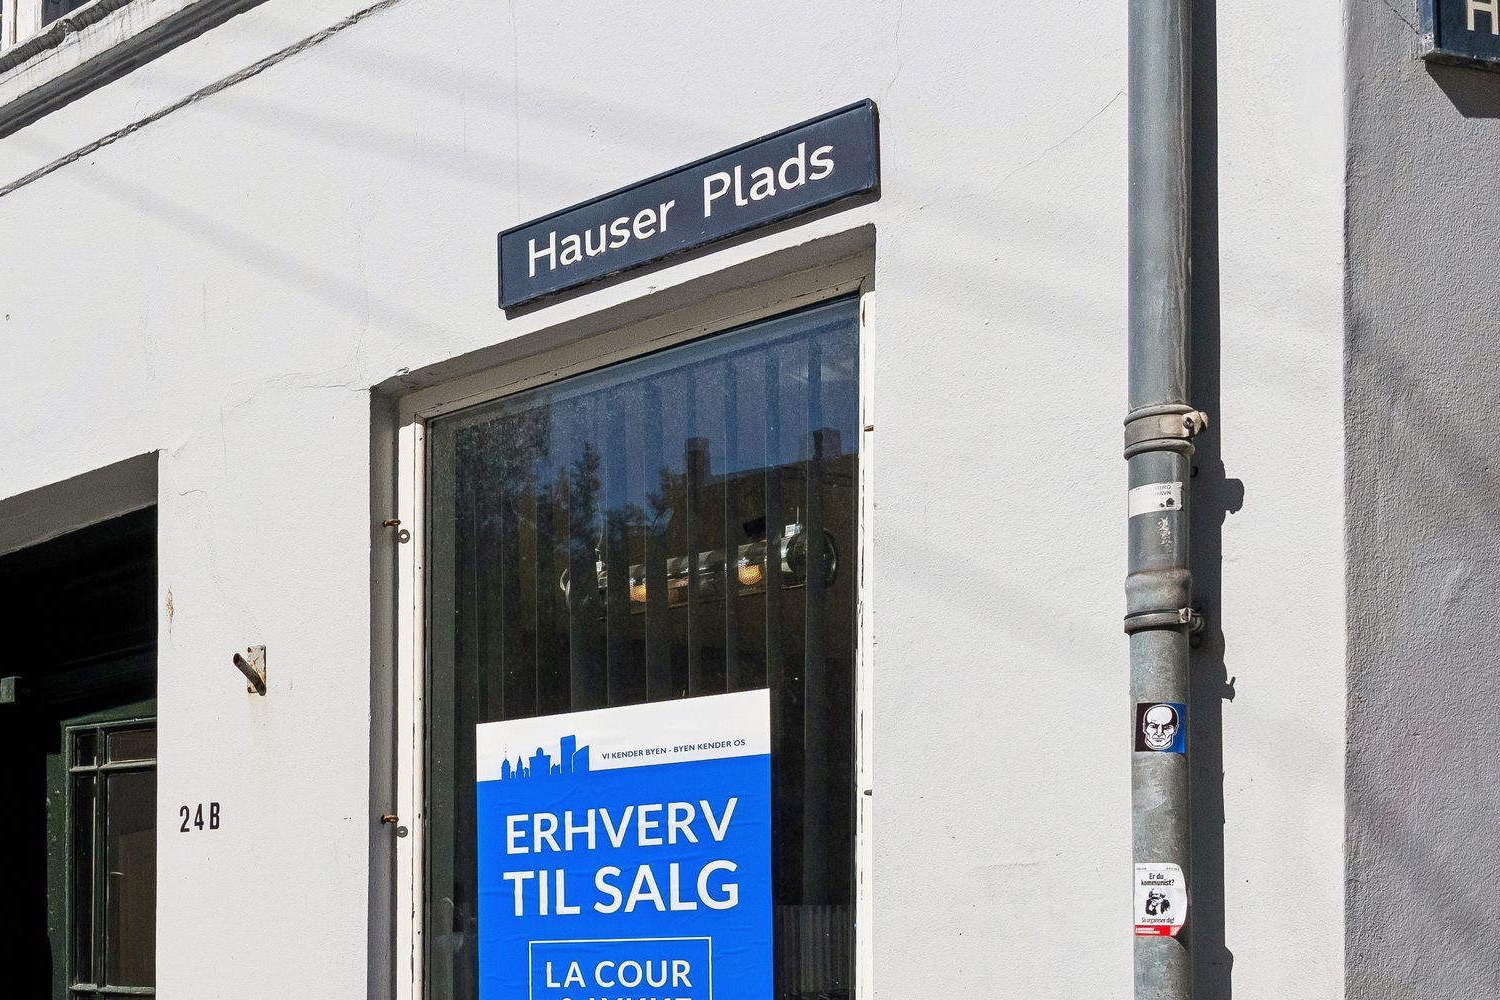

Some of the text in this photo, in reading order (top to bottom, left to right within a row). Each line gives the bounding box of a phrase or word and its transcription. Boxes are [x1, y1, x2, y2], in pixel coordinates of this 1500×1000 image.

[527, 141, 836, 278] Hauser Plads
[611, 749, 644, 759] KENDER
[645, 747, 667, 756] BYEN
[673, 744, 695, 753] BYEN
[697, 740, 732, 750] KENDER
[734, 738, 746, 747] OS
[179, 802, 220, 833] 24B
[506, 797, 739, 855] ERHVERV
[503, 859, 739, 917] TIL SALG
[546, 960, 692, 988] LA COUR
